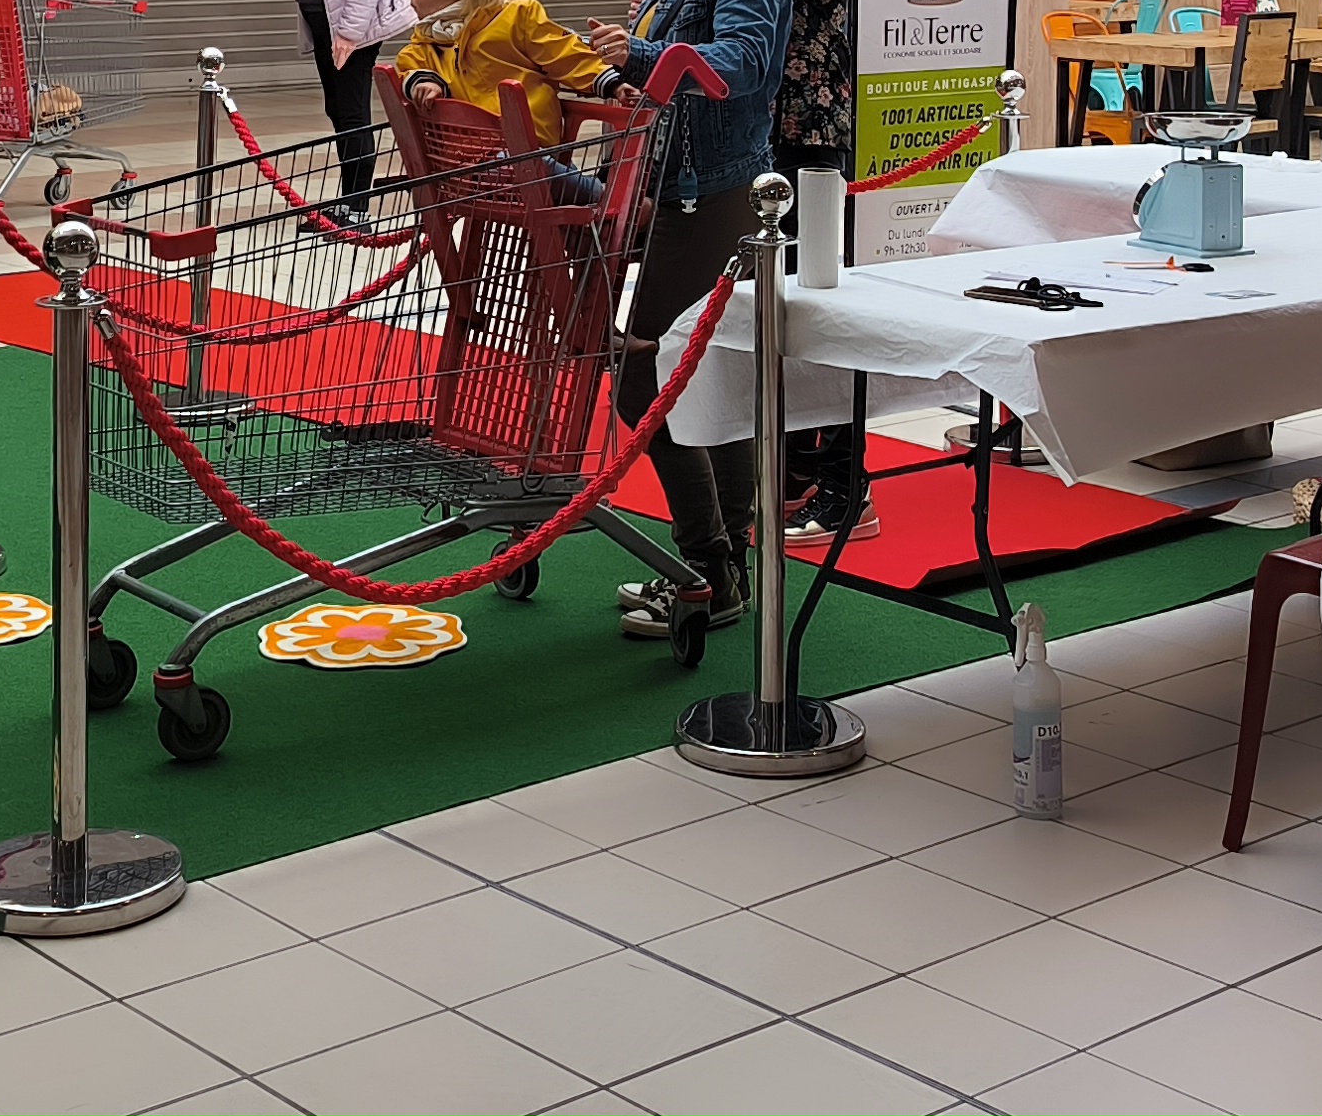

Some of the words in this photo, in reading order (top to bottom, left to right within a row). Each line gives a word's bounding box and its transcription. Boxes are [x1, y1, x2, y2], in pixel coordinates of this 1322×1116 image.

[867, 81, 929, 95] BOUTIQUE
[933, 76, 998, 90] ANTIGASP
[881, 108, 913, 126] 1001
[916, 103, 984, 123] ARTICLES
[890, 128, 973, 150] D'OCCASI
[867, 155, 877, 176] À
[896, 203, 933, 216] OUVERT
[888, 230, 901, 240] Du
[903, 228, 925, 239] lundi
[884, 242, 926, 256] 9h-12h30
